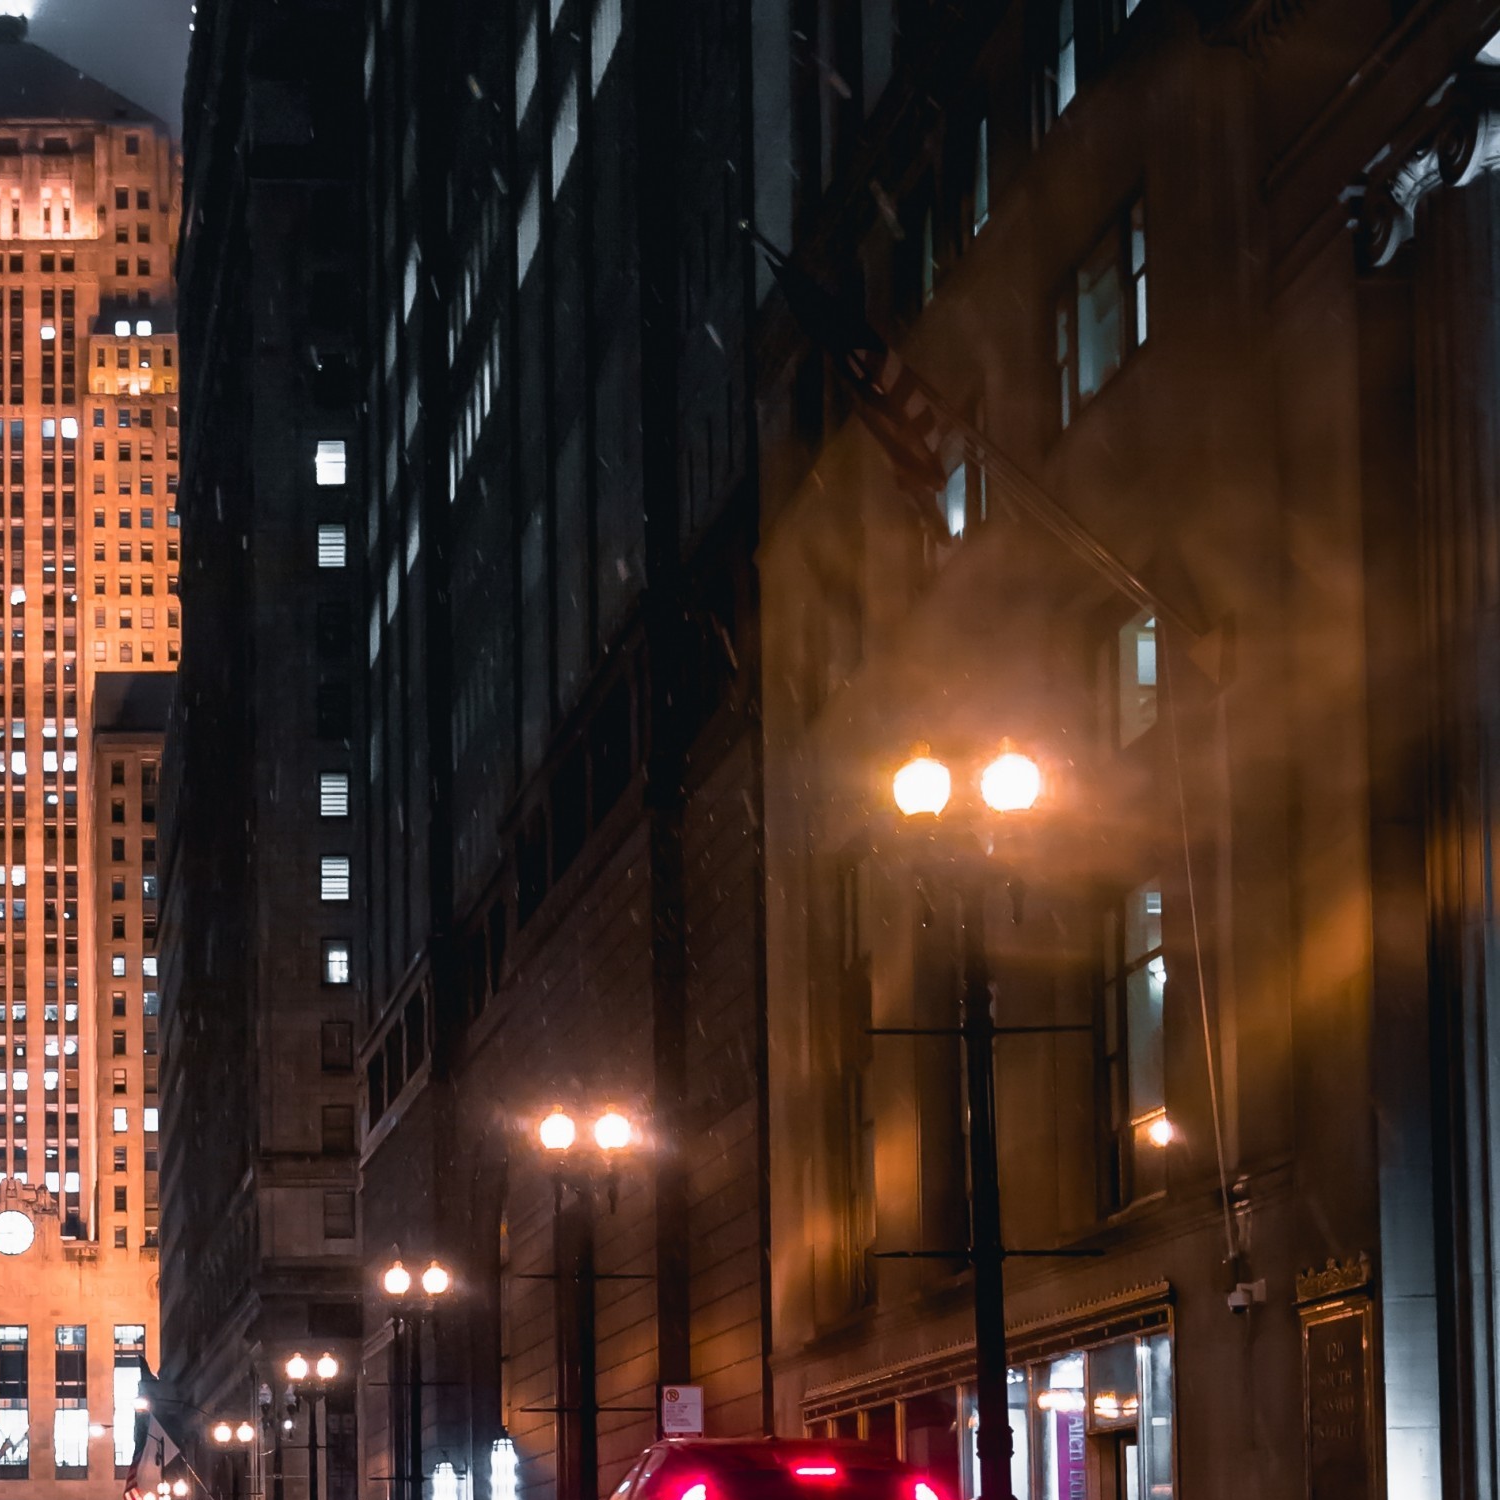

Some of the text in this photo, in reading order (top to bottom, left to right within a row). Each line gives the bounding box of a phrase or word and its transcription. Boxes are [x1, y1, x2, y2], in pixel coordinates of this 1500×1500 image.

[49, 1283, 72, 1299] OF
[79, 1283, 135, 1299] TRADE
[1326, 1341, 1344, 1363] 120
[1067, 1415, 1086, 1462] Allen
